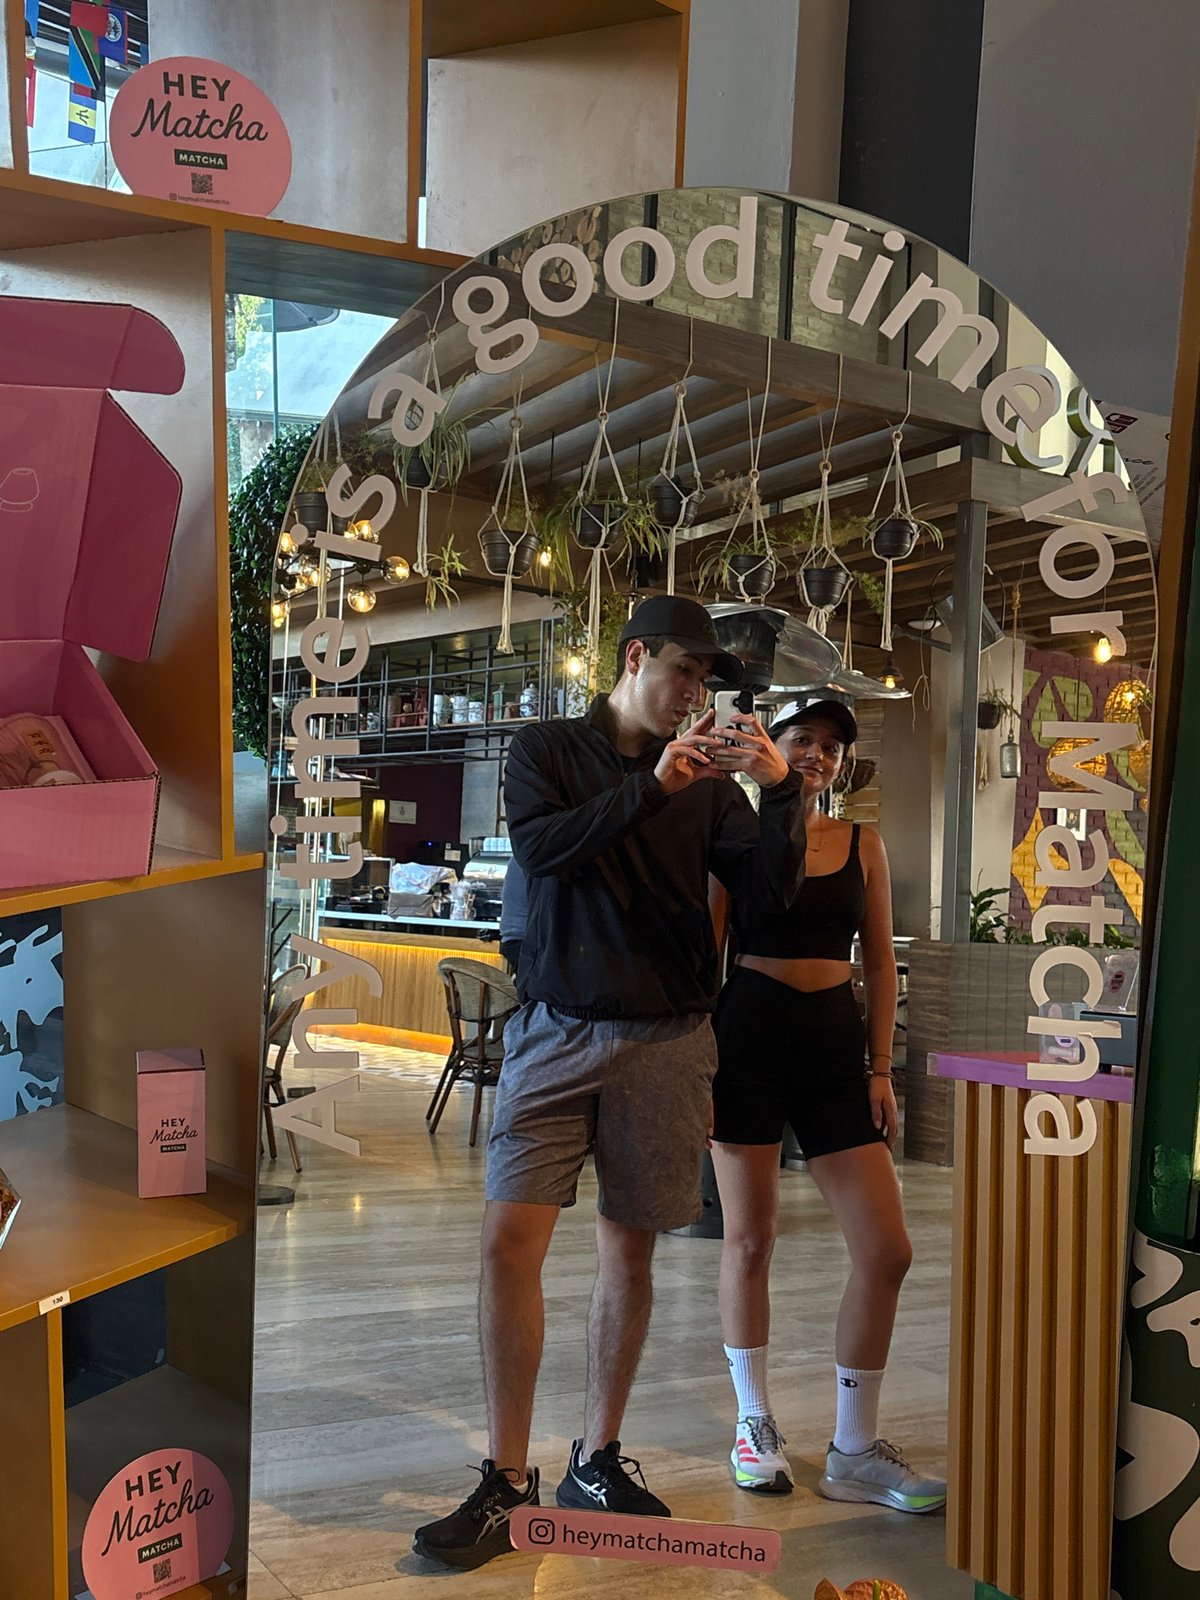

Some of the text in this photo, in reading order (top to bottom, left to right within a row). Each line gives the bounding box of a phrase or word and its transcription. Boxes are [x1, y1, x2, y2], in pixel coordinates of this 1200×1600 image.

[163, 72, 231, 101] HEY
[131, 98, 268, 141] Matcha
[179, 153, 224, 166] MATCHA
[452, 196, 758, 374] good
[808, 219, 1058, 445] time
[368, 373, 447, 447] a
[290, 463, 397, 561] is
[1020, 469, 1128, 656] for
[1024, 721, 1139, 1157] Matcha
[149, 1125, 198, 1144] Matcha
[161, 1118, 185, 1127] HEY
[125, 1461, 181, 1501] HEY
[101, 1478, 214, 1556] Matcha
[141, 1538, 180, 1559] MATCHA
[562, 1524, 766, 1562] heymatchamatcha
